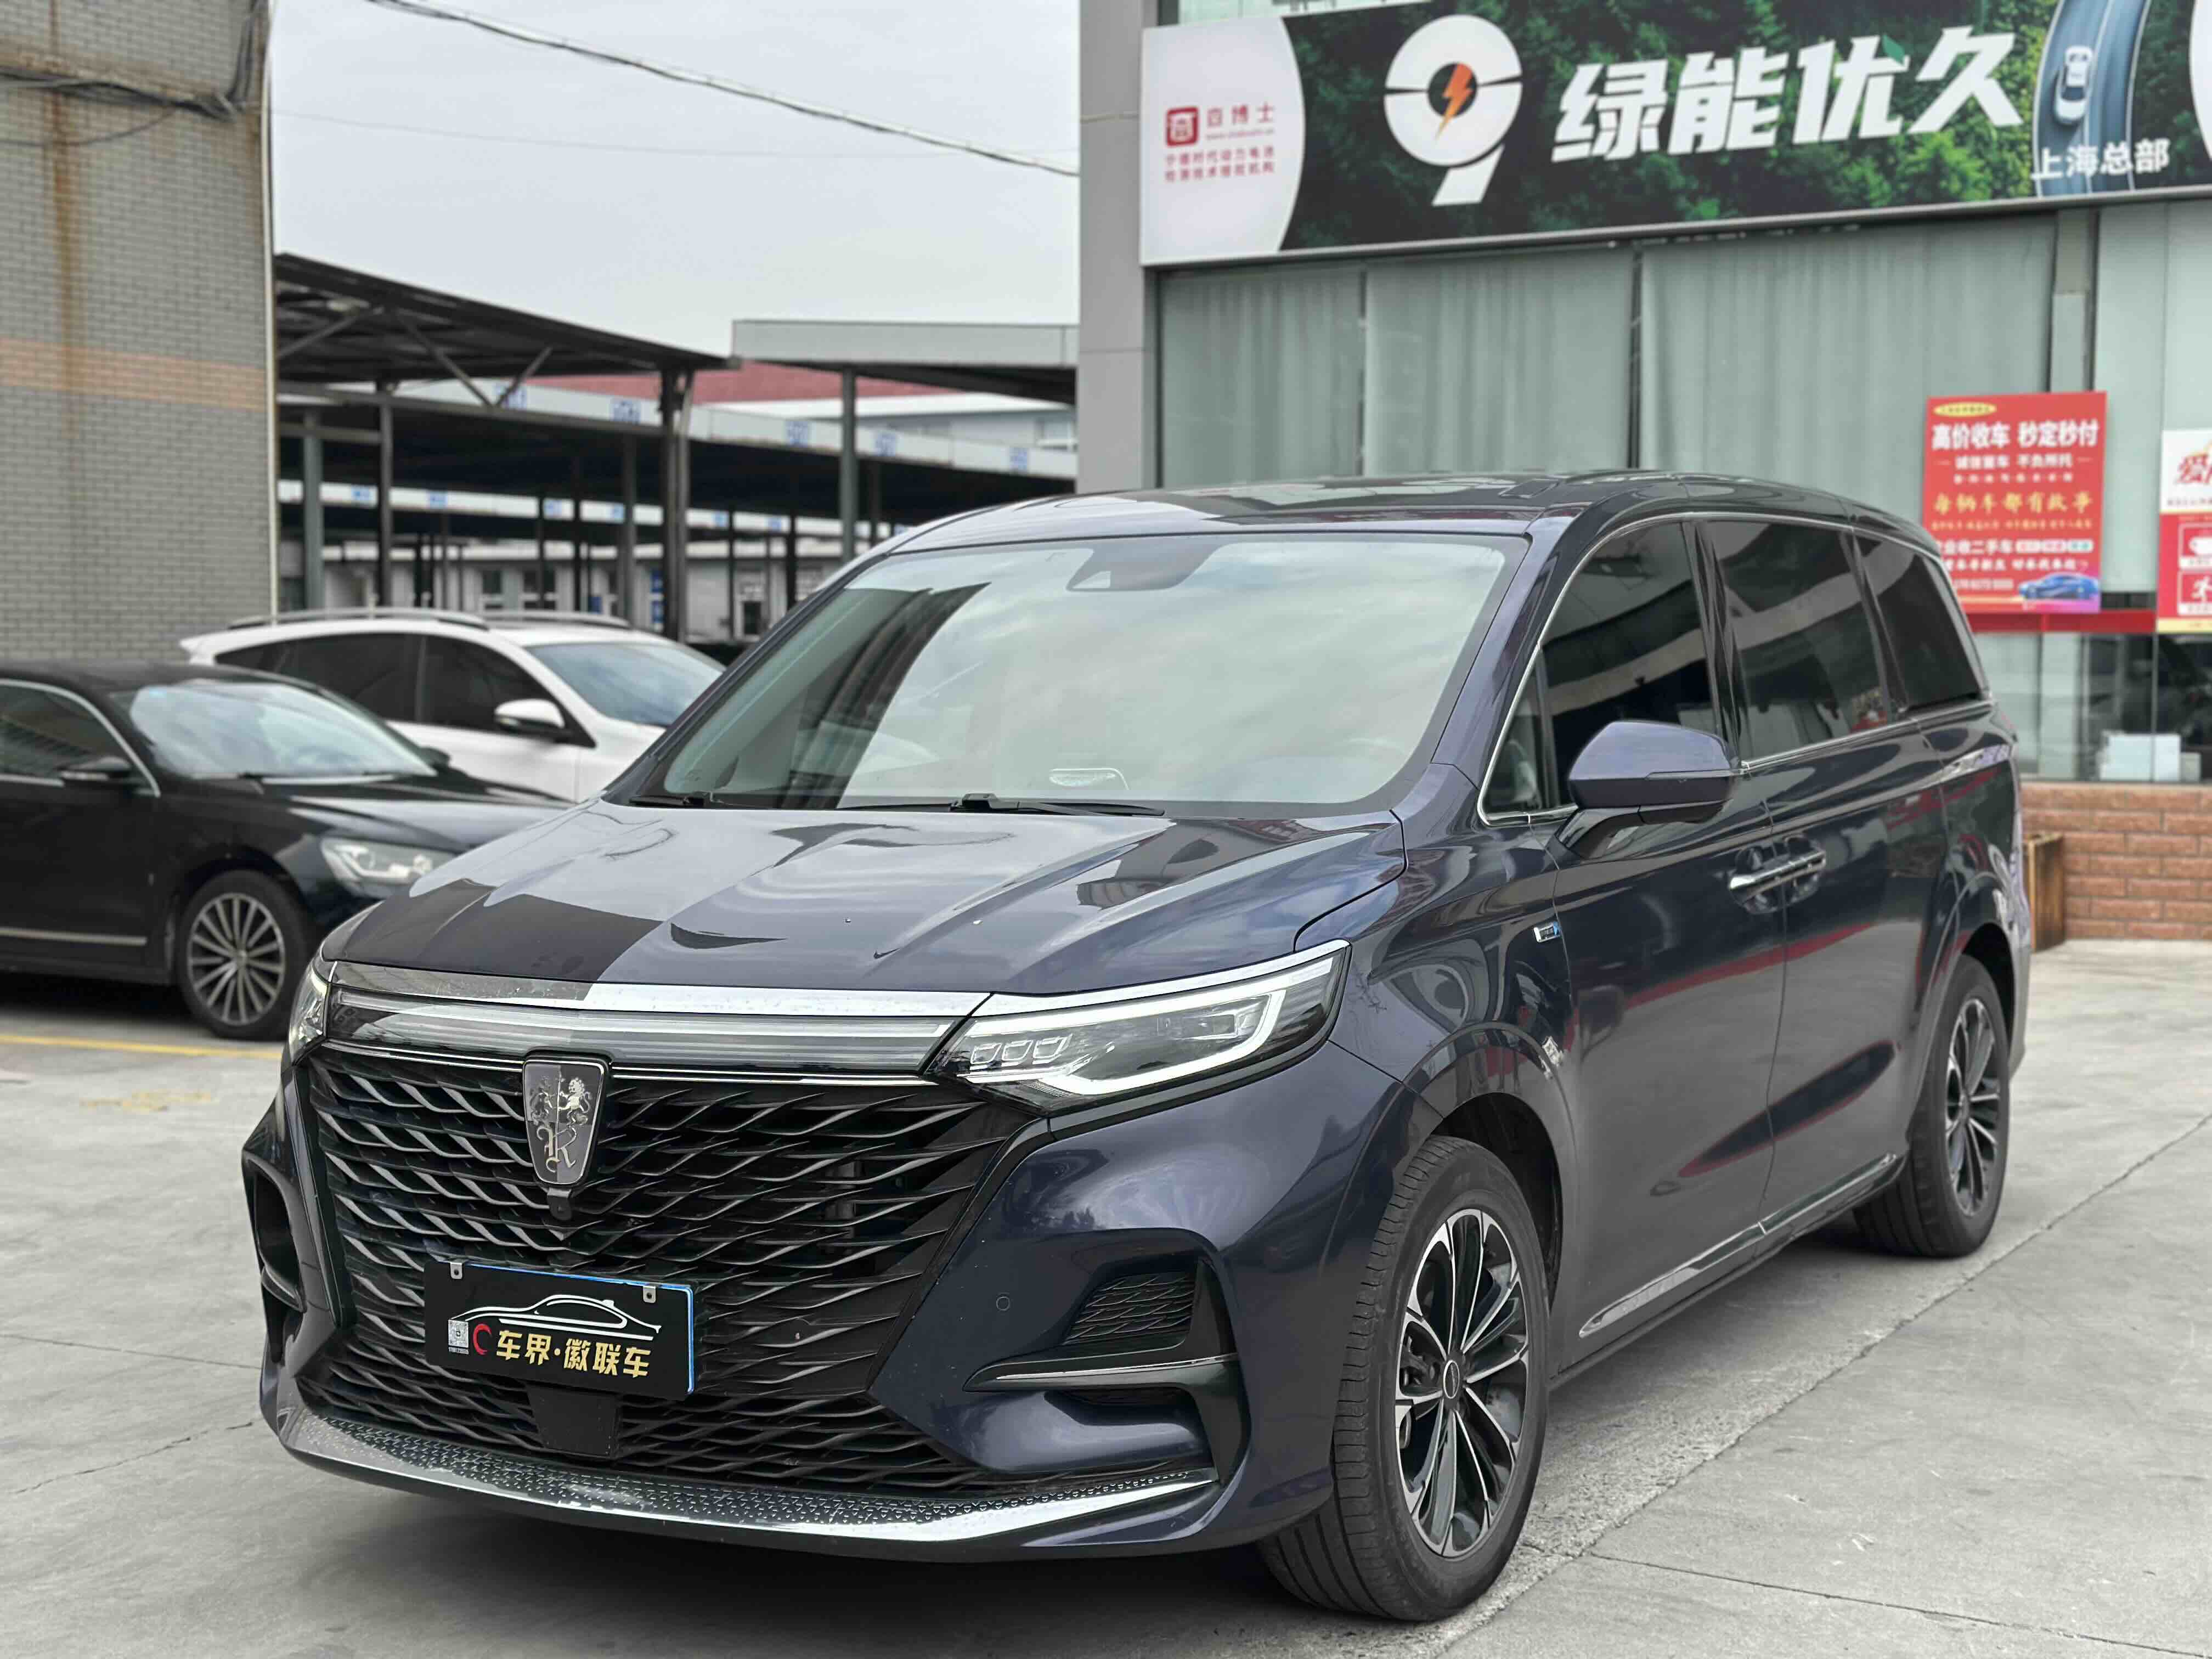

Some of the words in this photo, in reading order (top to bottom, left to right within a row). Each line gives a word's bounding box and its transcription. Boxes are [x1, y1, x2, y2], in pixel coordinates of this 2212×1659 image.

[1551, 25, 2023, 162] 绿能优久
[2030, 138, 2170, 181] 上海总部
[1931, 421, 2011, 450] 高价收车
[2017, 419, 2100, 448] 秒定秒付
[496, 1330, 651, 1378] 车界·徽联车
